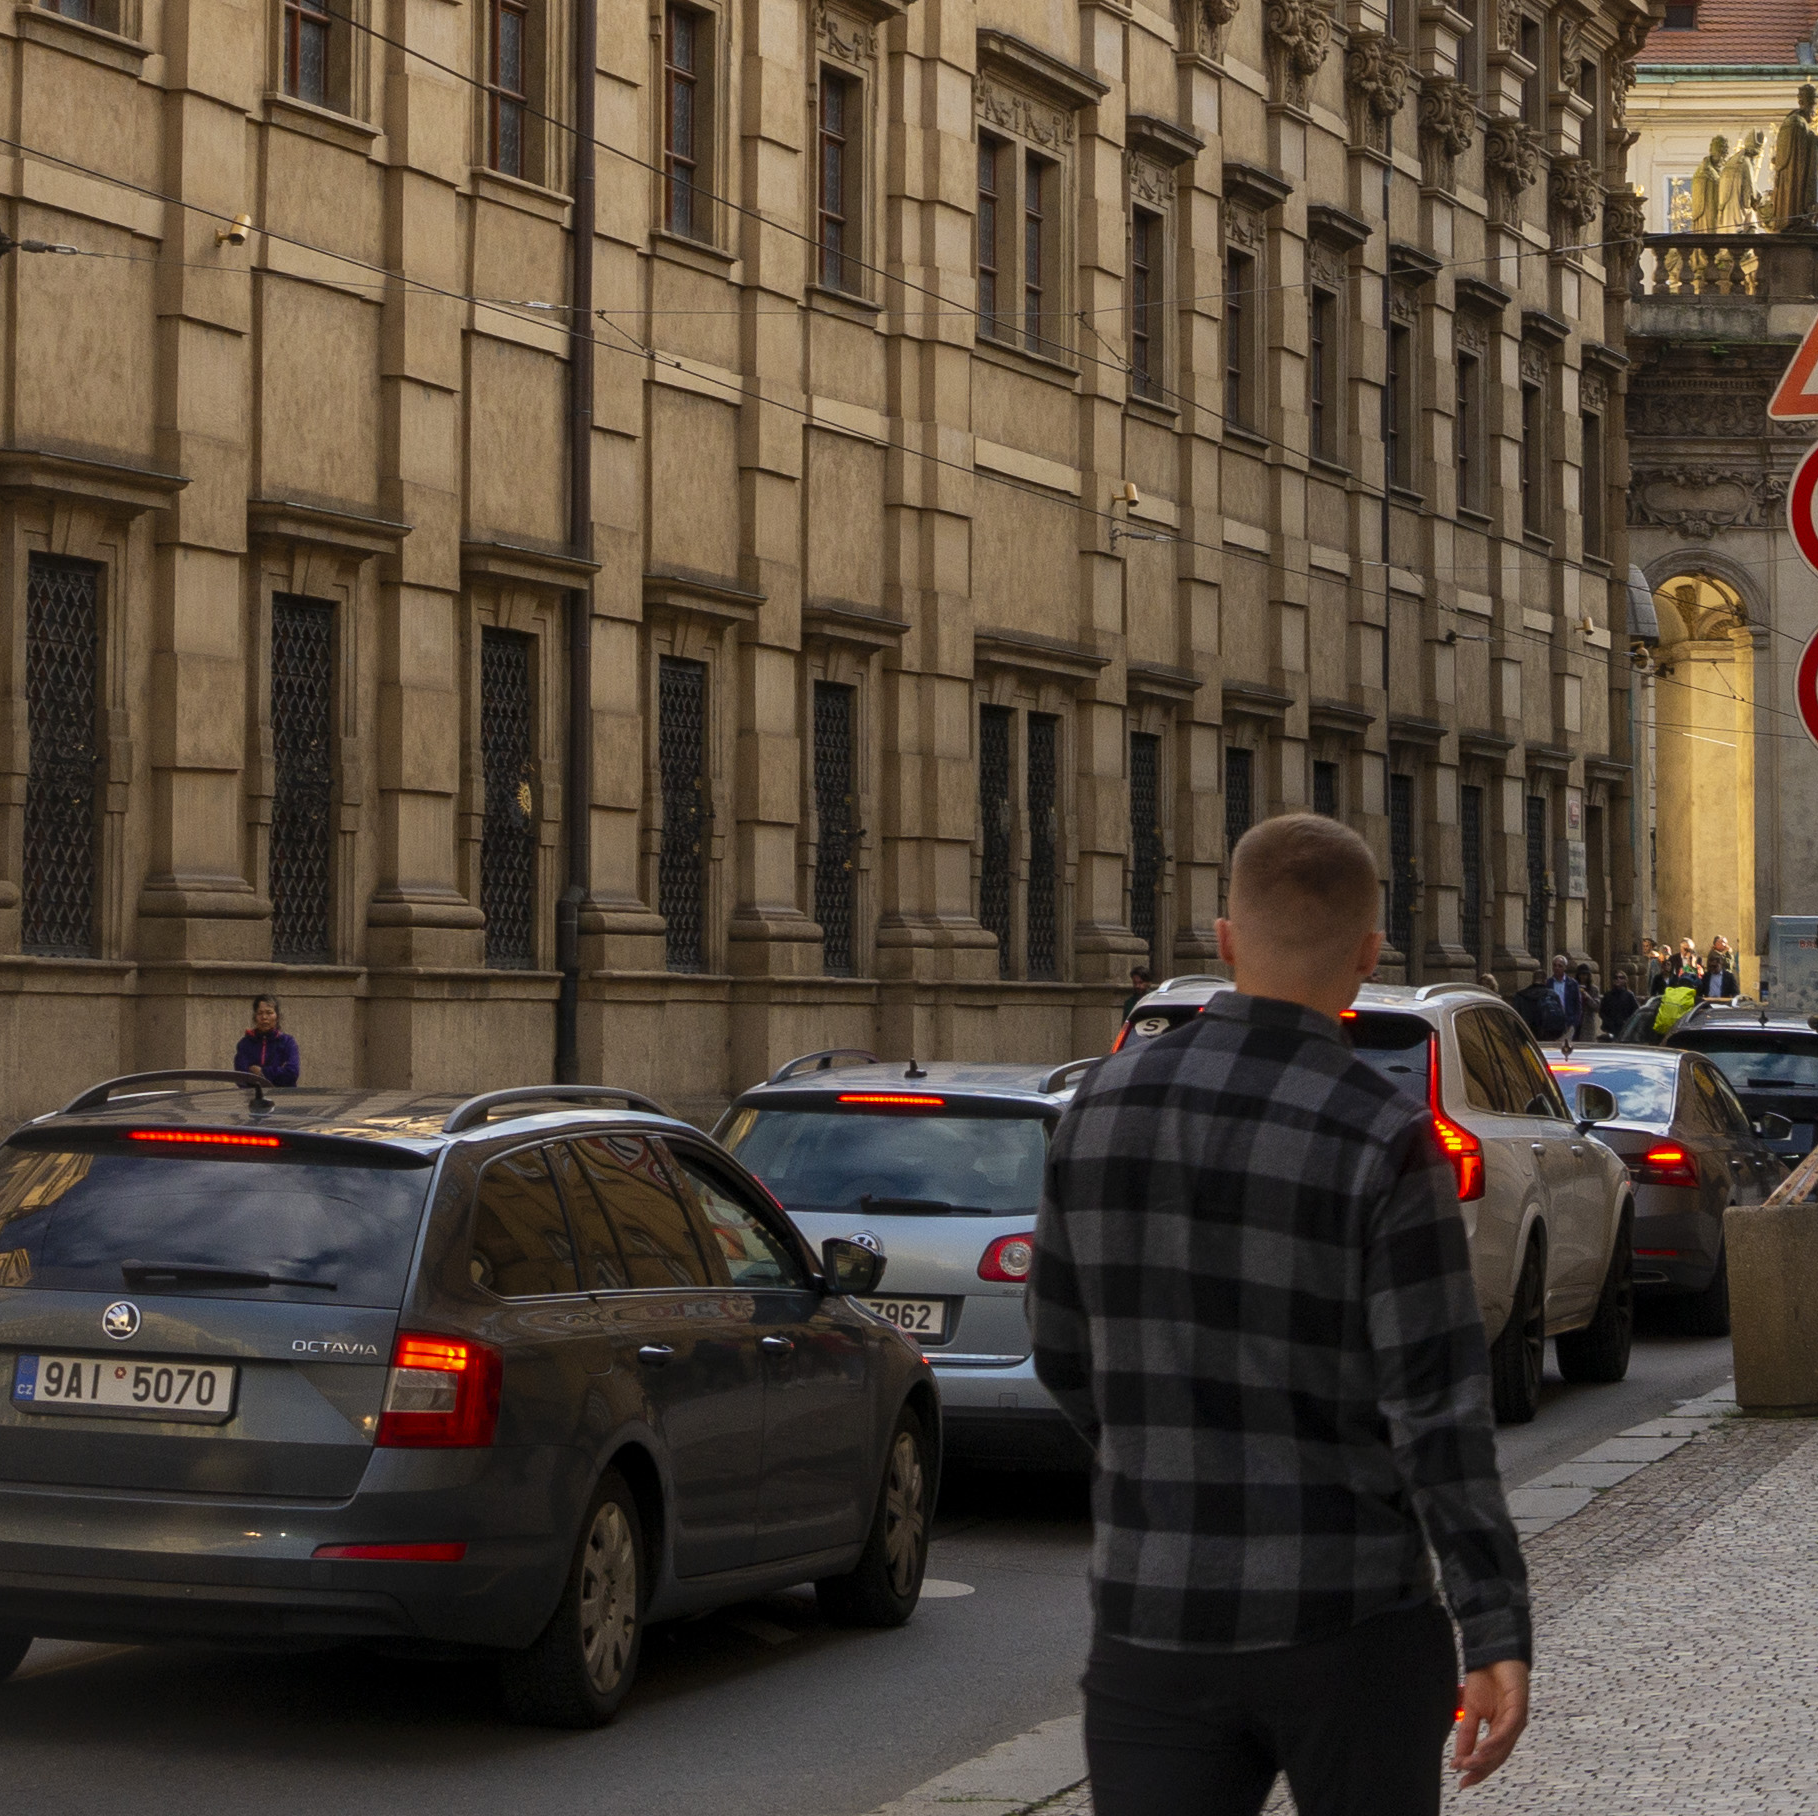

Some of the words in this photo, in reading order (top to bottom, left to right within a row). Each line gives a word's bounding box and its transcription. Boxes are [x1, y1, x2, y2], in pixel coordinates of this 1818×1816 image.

[1143, 1019, 1160, 1032] S
[291, 1339, 378, 1356] OCTAVIA
[17, 1384, 33, 1395] CZ
[132, 1366, 216, 1405] 5070
